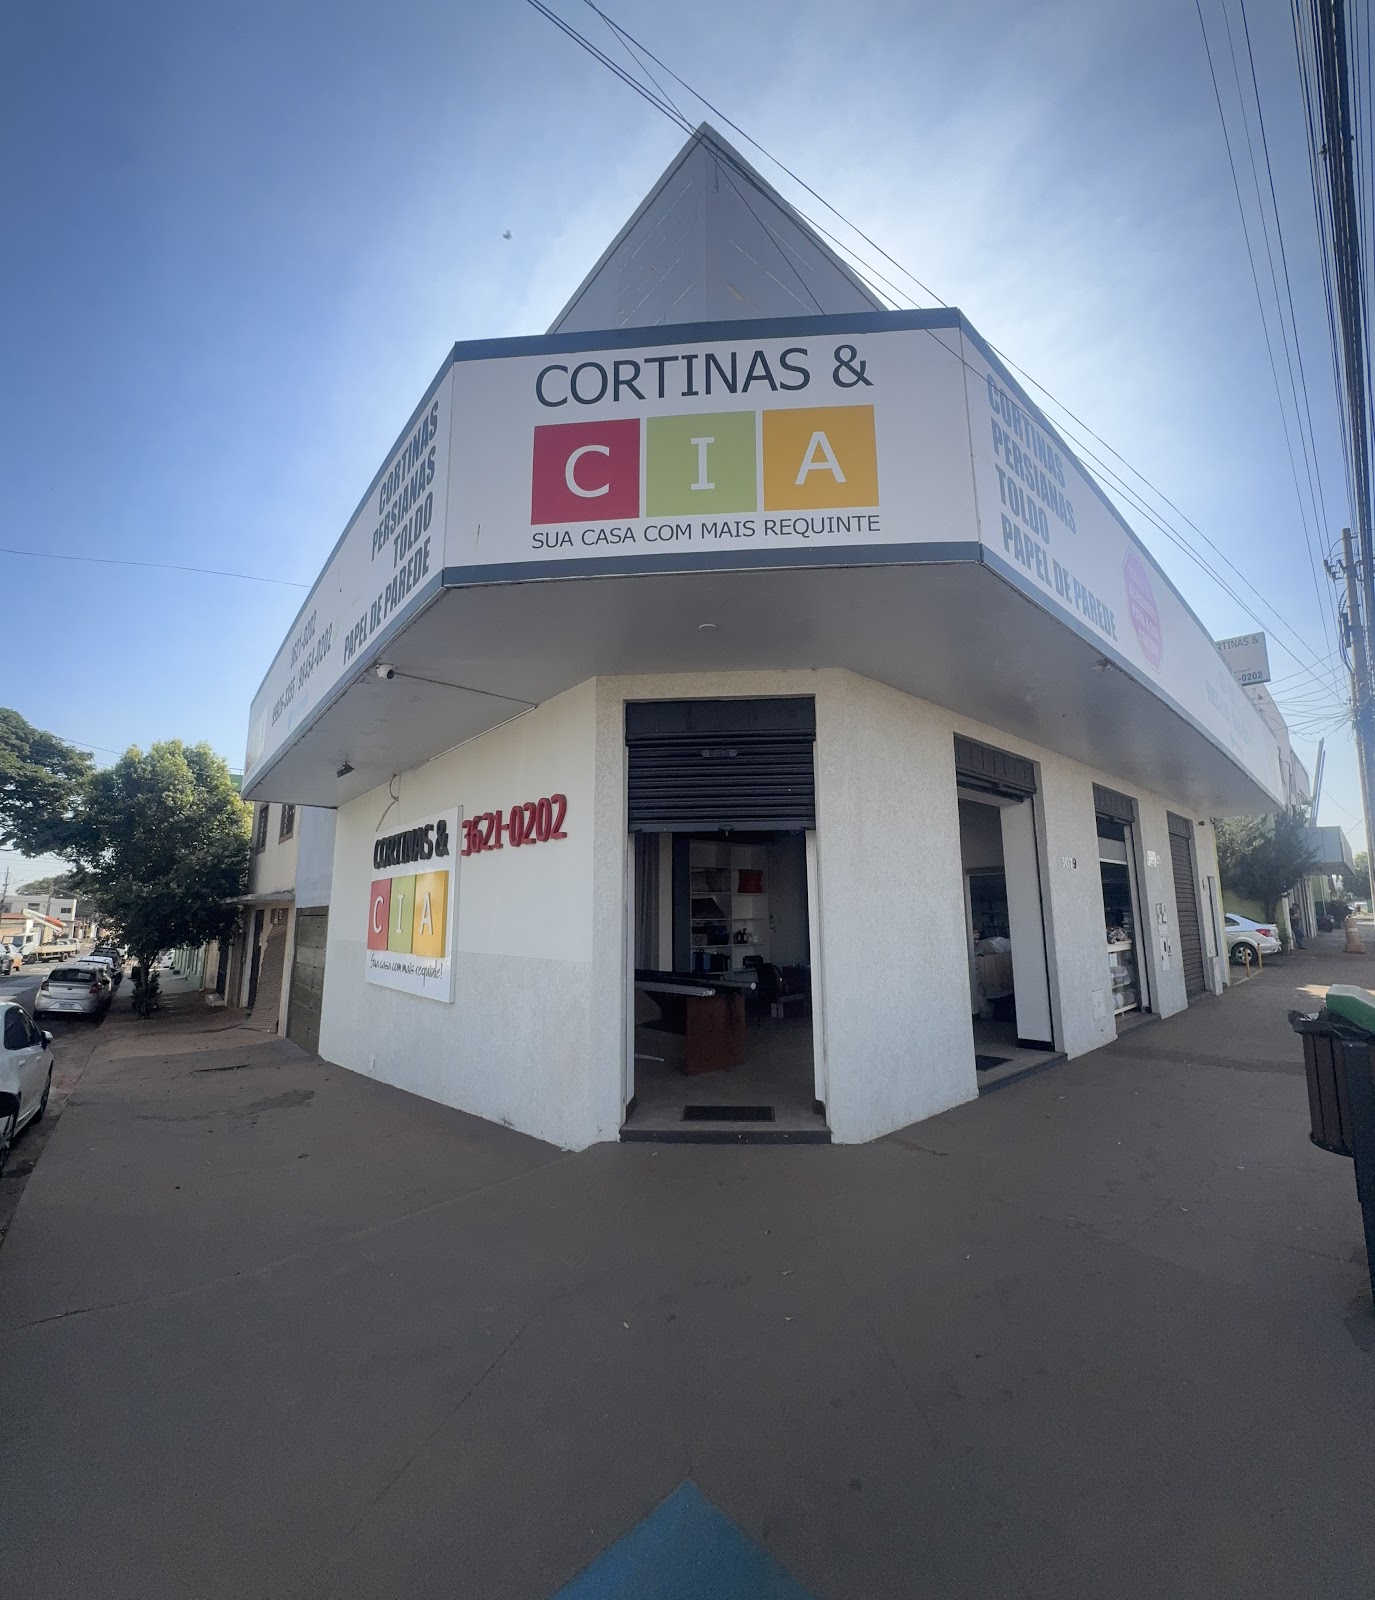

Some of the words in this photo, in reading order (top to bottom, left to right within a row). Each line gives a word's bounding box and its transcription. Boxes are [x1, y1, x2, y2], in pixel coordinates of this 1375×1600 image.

[535, 347, 810, 408] CORTINAS
[832, 344, 874, 387] &
[379, 400, 438, 516] CORTINAS
[986, 373, 1066, 488] CORTINAS
[371, 445, 436, 562] PERSIANAS
[990, 416, 1077, 534] PERSIANAS
[994, 463, 1050, 545] TOLDO
[393, 491, 433, 569] TOLDO
[532, 531, 574, 549] SUA
[581, 527, 636, 546] CASA
[644, 523, 692, 542] COM
[701, 520, 756, 539] MAIS
[764, 515, 881, 538] REQUINTE
[343, 612, 368, 665] PAPEL
[369, 592, 383, 634] DE
[384, 536, 431, 619] PAREDE
[1001, 512, 1052, 588] PAPEL
[1052, 558, 1072, 604] DE
[1073, 576, 1118, 642] PAREDE
[373, 824, 434, 869] CORTINAS
[435, 820, 449, 857] &
[461, 794, 567, 856] 3621-0202
[380, 960, 391, 970] casa
